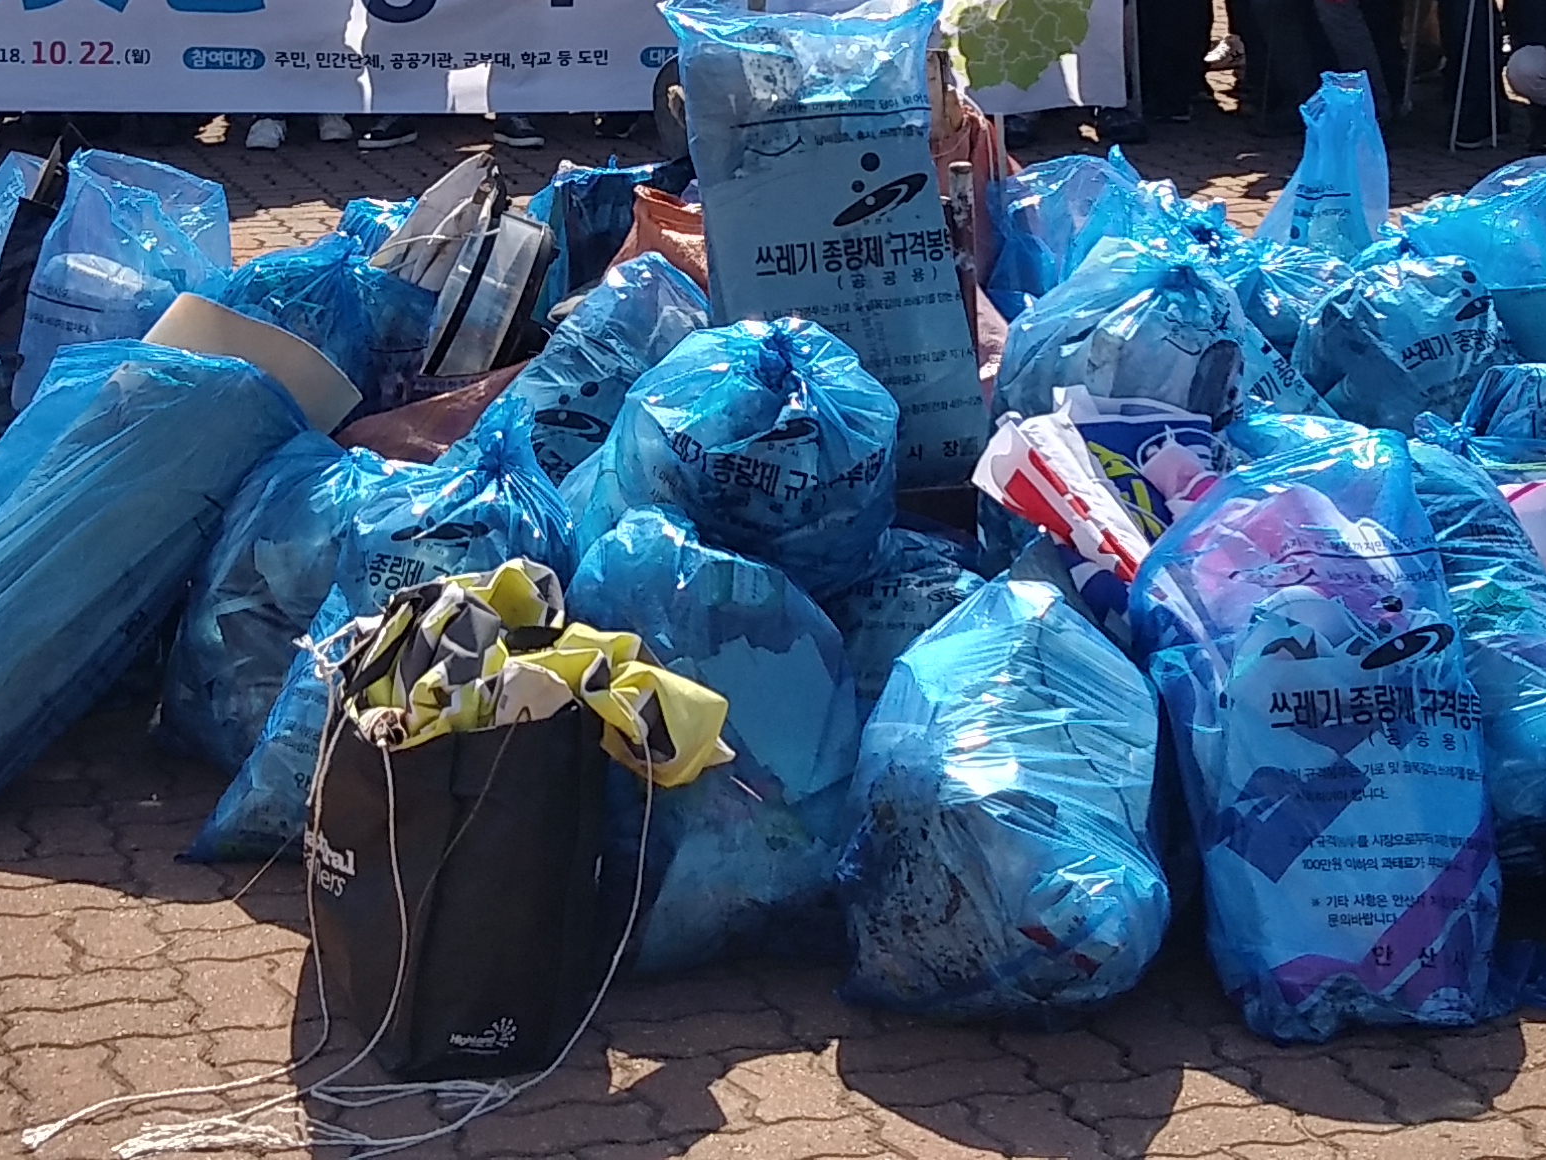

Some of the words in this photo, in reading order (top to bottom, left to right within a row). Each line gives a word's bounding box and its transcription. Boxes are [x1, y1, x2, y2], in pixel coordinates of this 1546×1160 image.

[124, 49, 152, 66] (월)
[192, 49, 257, 68] 참여대상
[274, 52, 310, 69] 주민,
[316, 53, 385, 71] 민간단체,
[390, 53, 459, 71] 공공기관,
[462, 51, 516, 69] 군부대,
[521, 51, 551, 67] 학교
[553, 51, 573, 67] 등
[577, 50, 609, 66] 도민
[755, 241, 818, 277] 쓰레기
[821, 234, 885, 272] 종량제
[1399, 333, 1454, 370] 쓰레기
[713, 454, 781, 498] 종량제
[368, 552, 425, 591] 종량제
[1269, 688, 1343, 729] 쓰레기
[1349, 685, 1416, 725] 종량제
[1326, 895, 1350, 909] 기타
